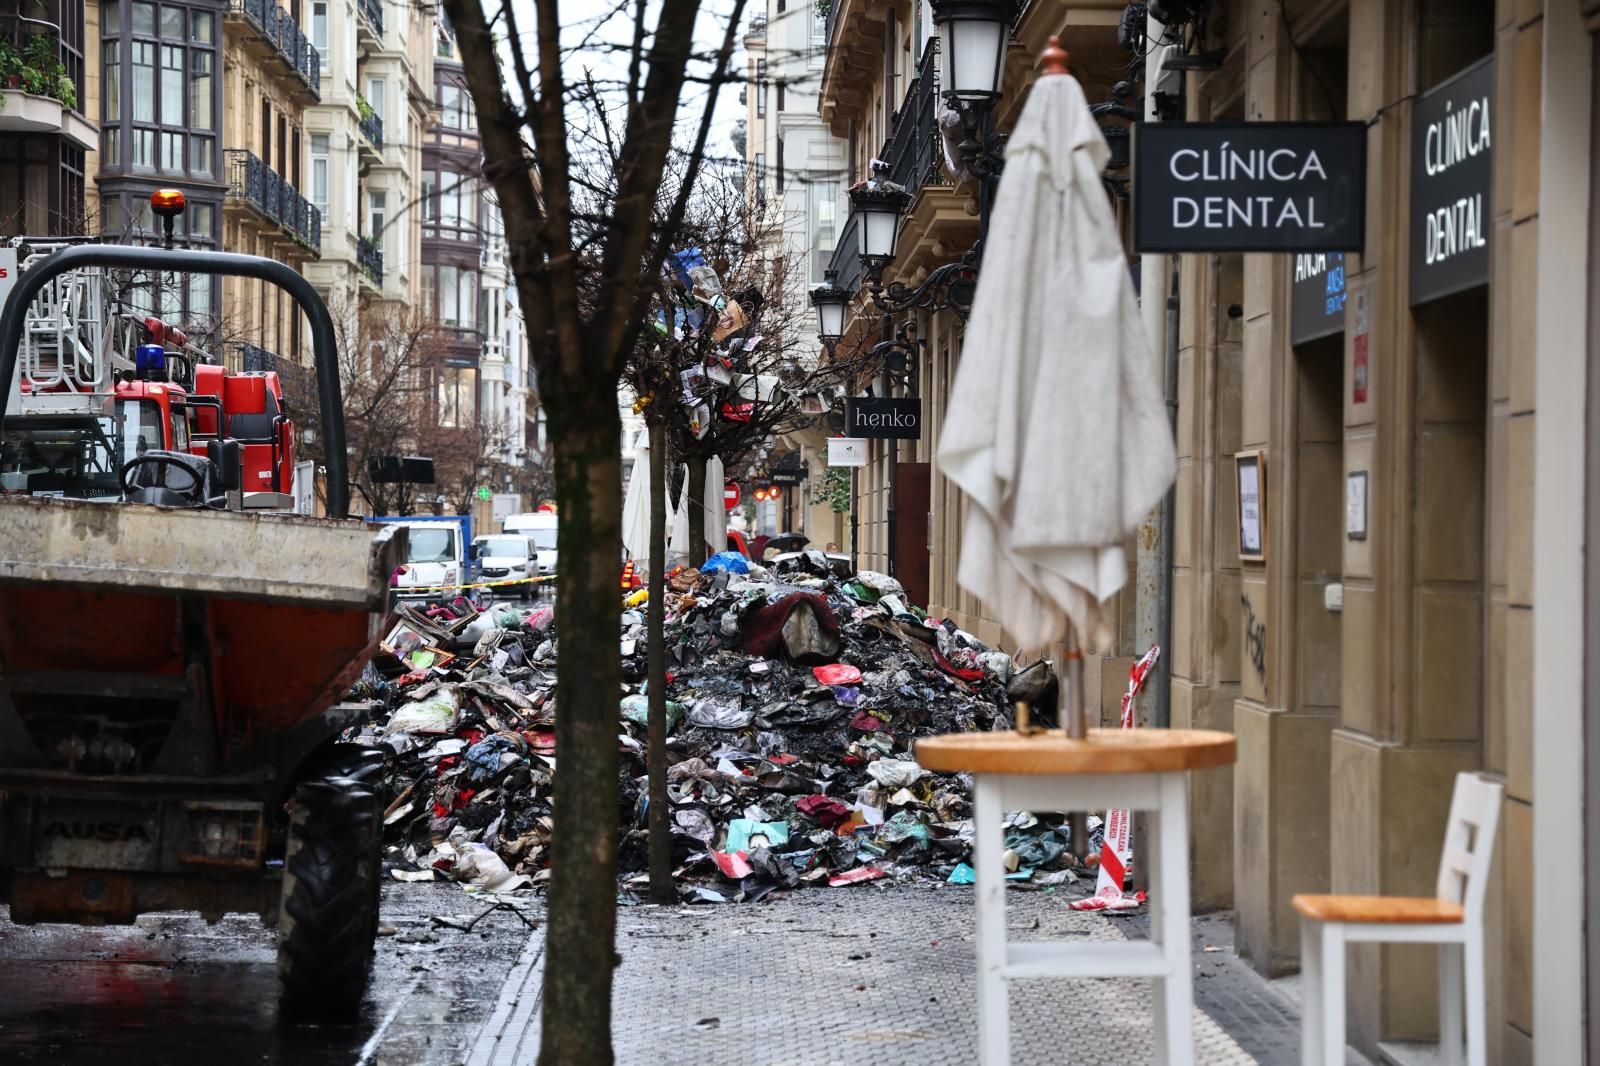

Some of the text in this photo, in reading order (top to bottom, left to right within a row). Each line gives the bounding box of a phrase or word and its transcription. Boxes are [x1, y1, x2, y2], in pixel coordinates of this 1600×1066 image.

[1424, 97, 1491, 177] CLÍNICA
[1169, 141, 1327, 181] CLÍNICA
[1172, 197, 1325, 228] DENTAL
[1425, 193, 1486, 265] DENTAL
[855, 407, 916, 429] henko
[42, 821, 152, 842] AUSA
